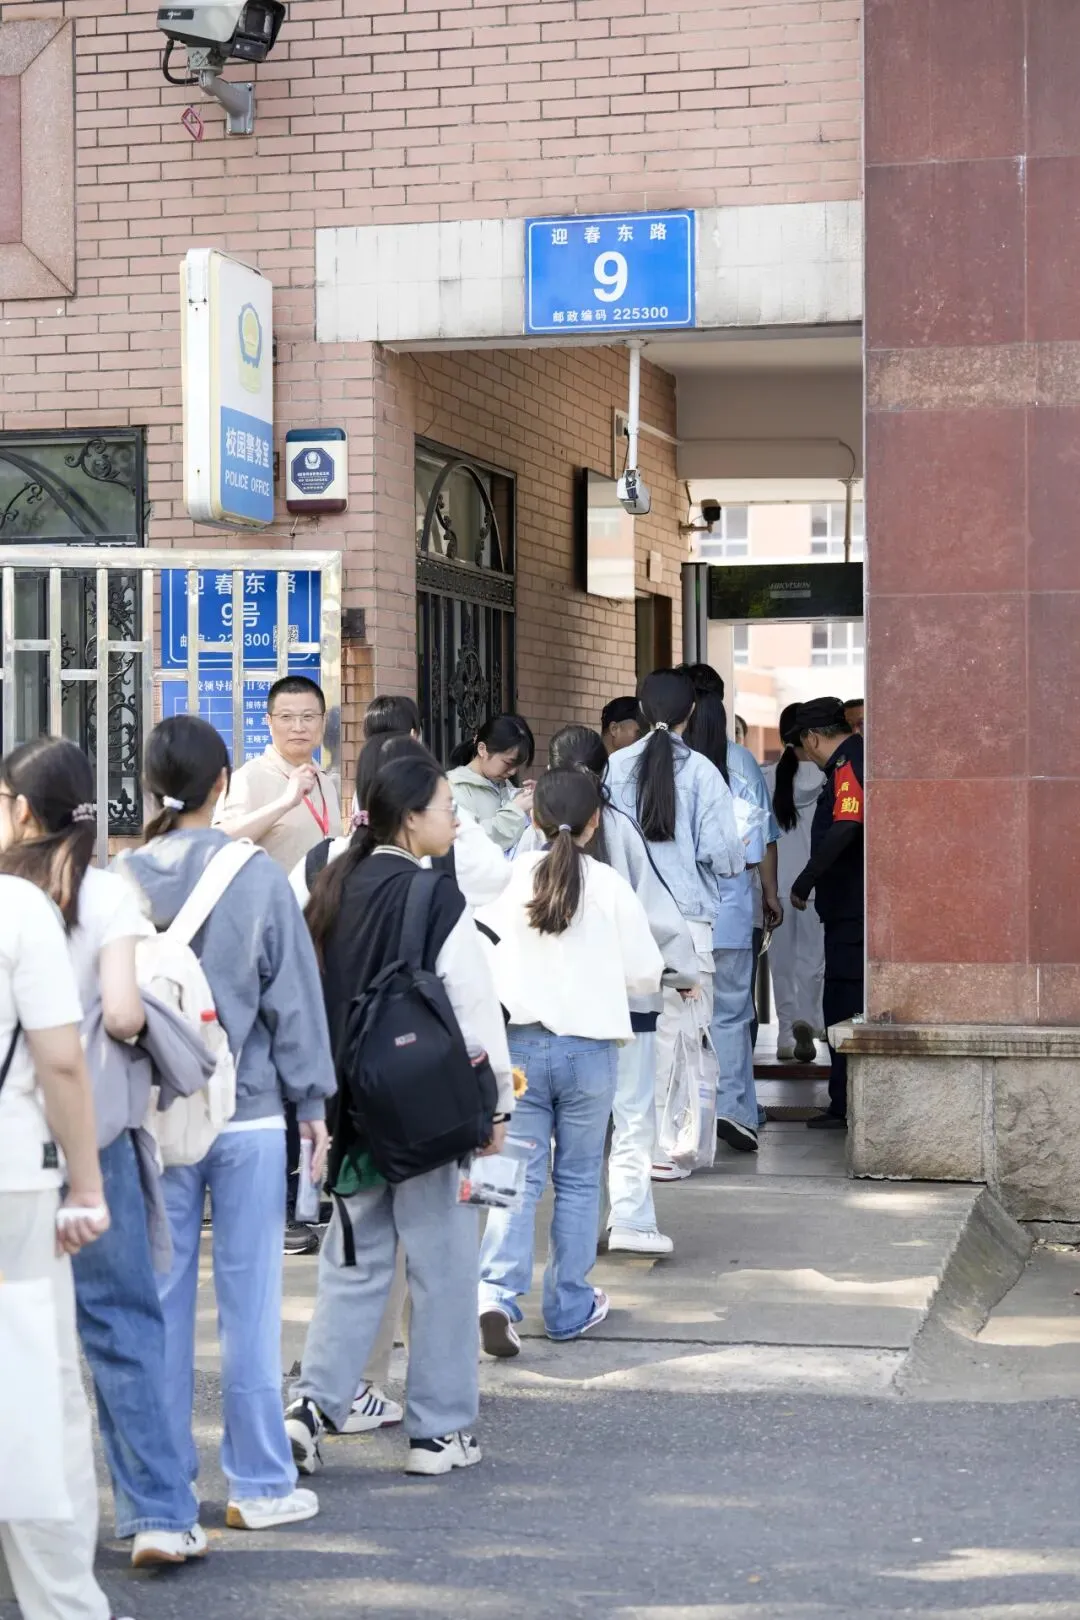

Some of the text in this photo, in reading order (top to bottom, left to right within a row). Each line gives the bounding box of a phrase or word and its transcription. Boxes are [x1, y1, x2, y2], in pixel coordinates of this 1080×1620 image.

[552, 222, 667, 245] 迎春东路
[593, 250, 628, 302] 9
[553, 307, 668, 323] 邮政编码 225300
[226, 426, 270, 468] 校园警务室
[225, 469, 270, 497] POLICE OFFICE
[221, 602, 260, 627] 9号
